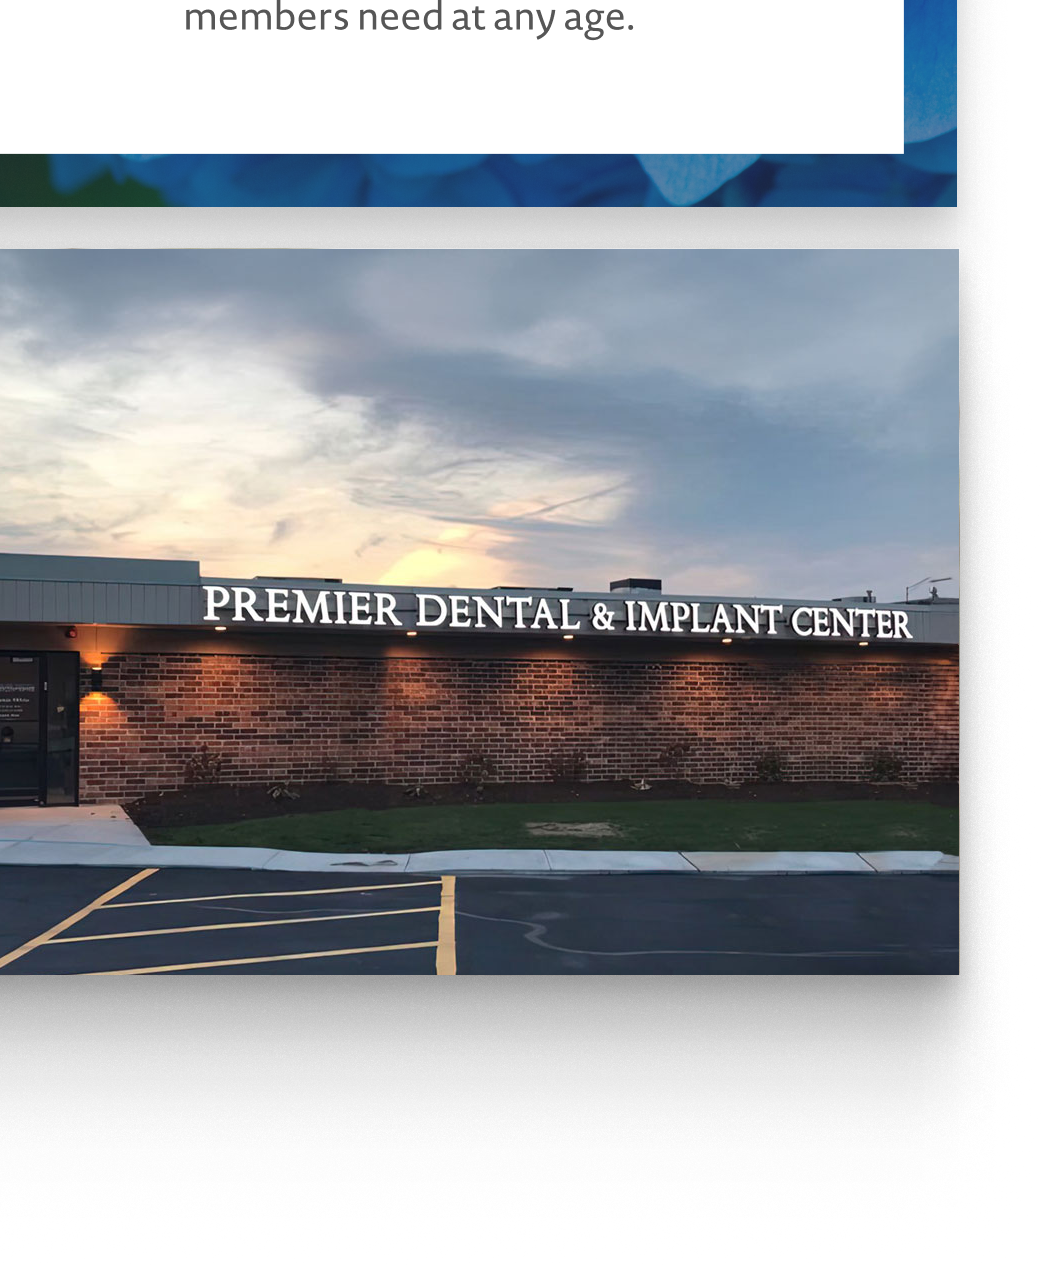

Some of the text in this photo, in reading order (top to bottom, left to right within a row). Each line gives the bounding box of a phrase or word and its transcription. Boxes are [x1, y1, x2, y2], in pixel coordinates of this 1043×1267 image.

[202, 585, 914, 640] PREMIER DENTAL & IMPLANT CENTER
